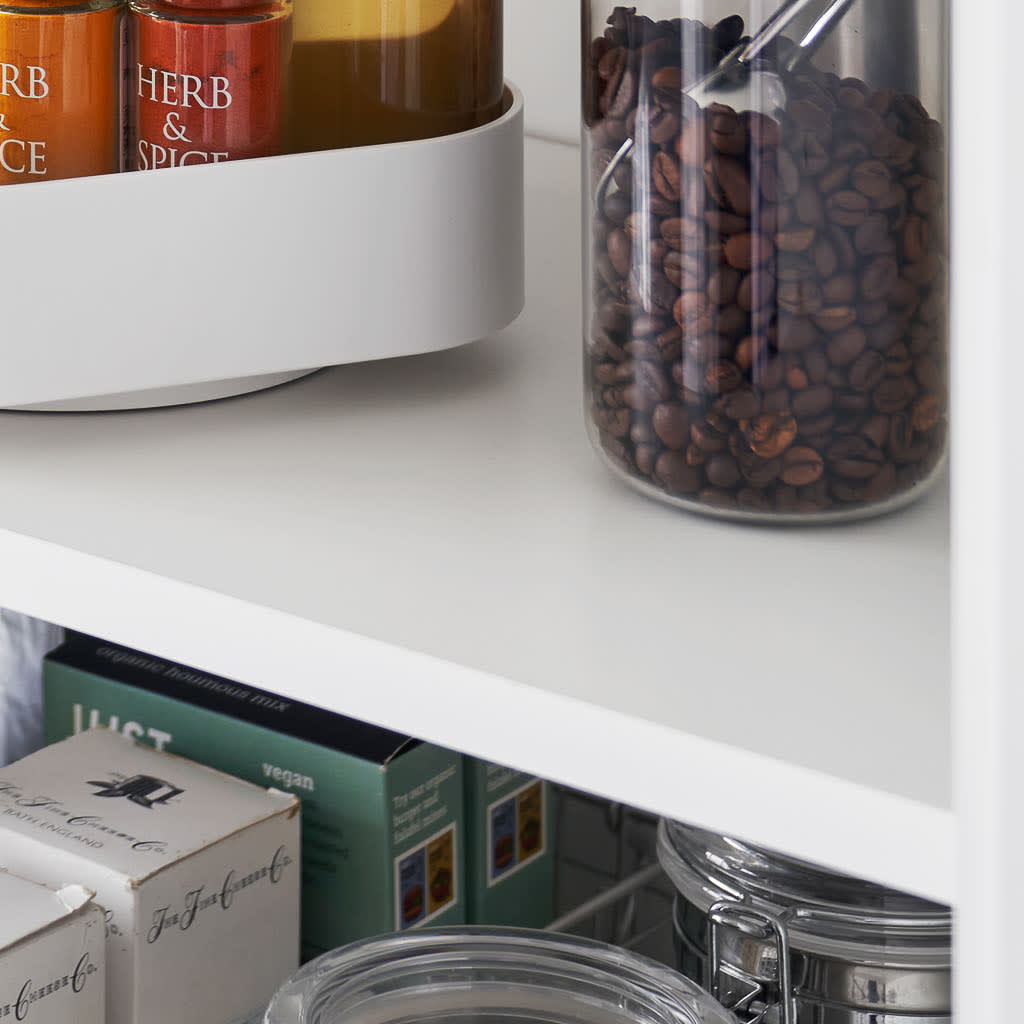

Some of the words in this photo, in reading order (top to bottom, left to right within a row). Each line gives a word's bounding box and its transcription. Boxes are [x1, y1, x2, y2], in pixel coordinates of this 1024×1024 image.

[138, 63, 233, 109] HERB
[162, 112, 192, 143] &
[96, 645, 164, 674] organic
[164, 664, 252, 700] houmous
[250, 691, 292, 713] mix
[262, 762, 315, 792] vegan
[3, 807, 38, 824] BATH
[39, 821, 105, 850] ENGLAND
